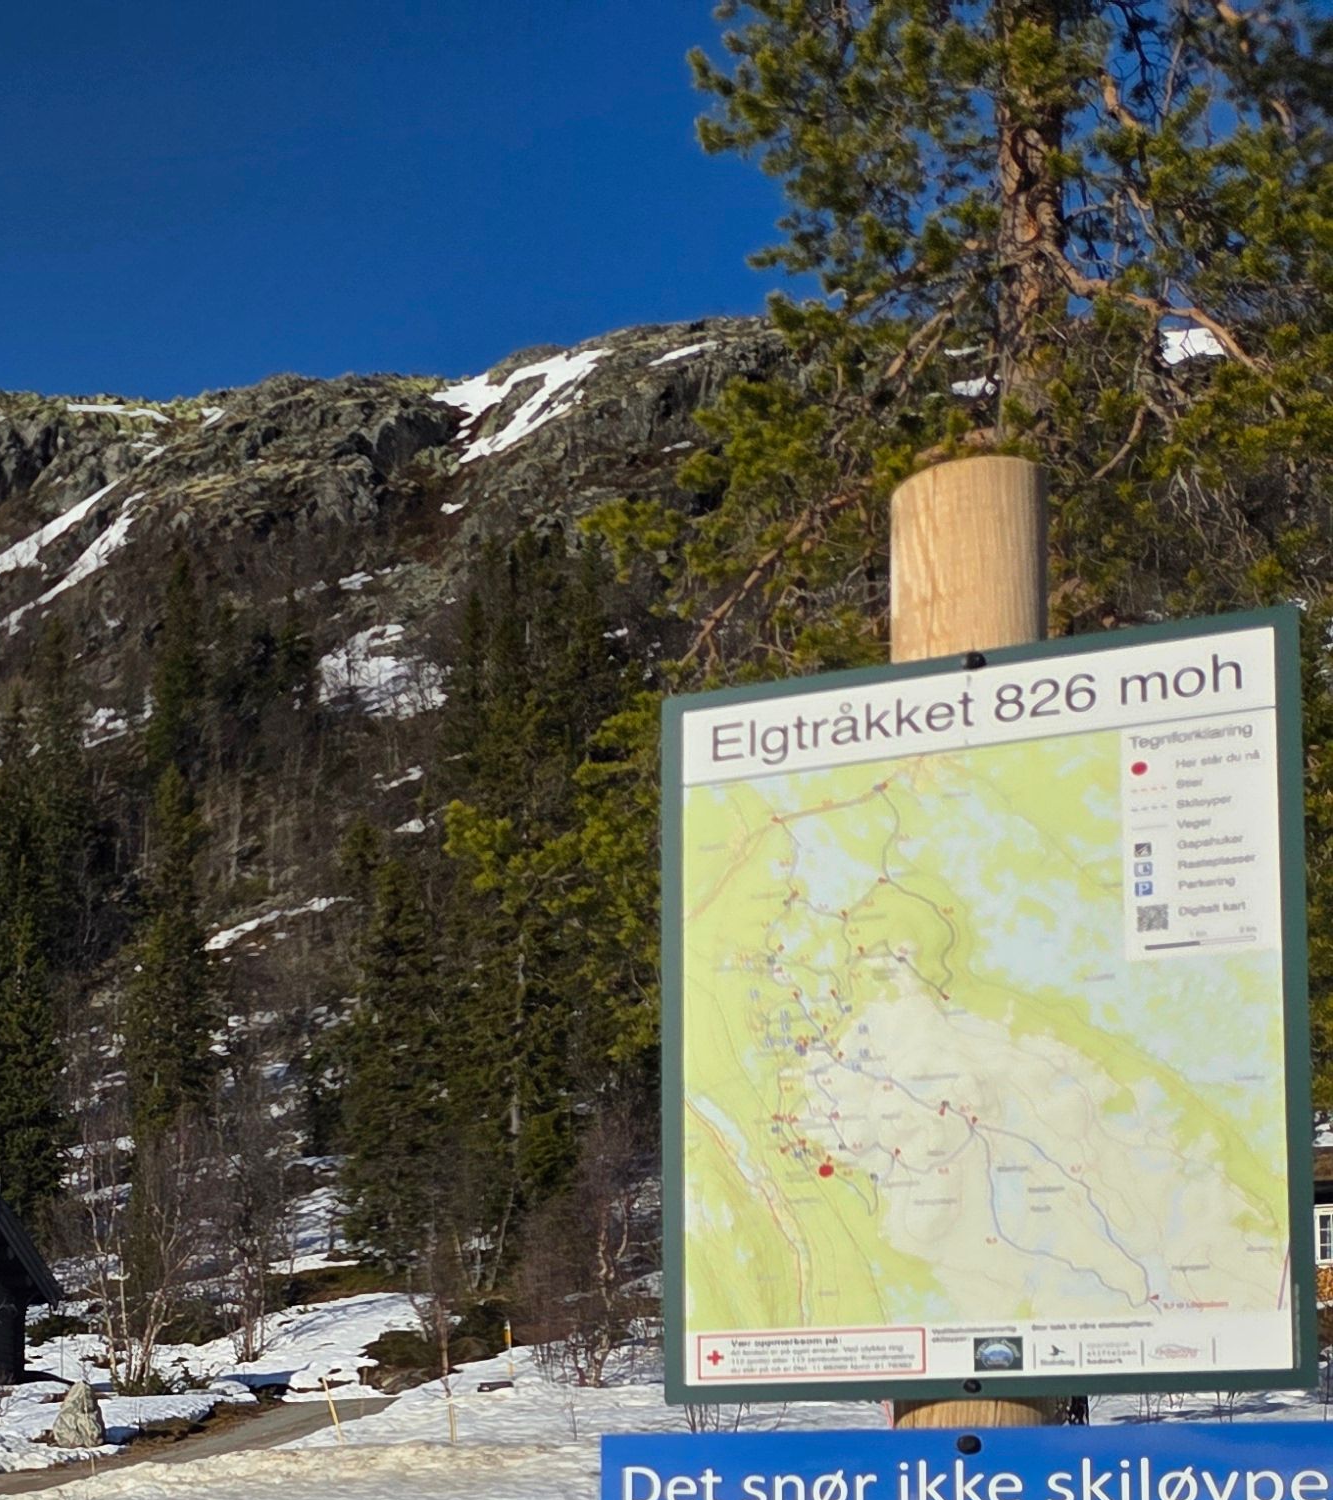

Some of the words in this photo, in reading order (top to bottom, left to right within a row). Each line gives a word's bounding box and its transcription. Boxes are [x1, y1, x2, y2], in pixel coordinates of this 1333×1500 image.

[711, 691, 976, 766] Elgtråkket
[992, 672, 1098, 723] 826
[1119, 653, 1244, 706] moh
